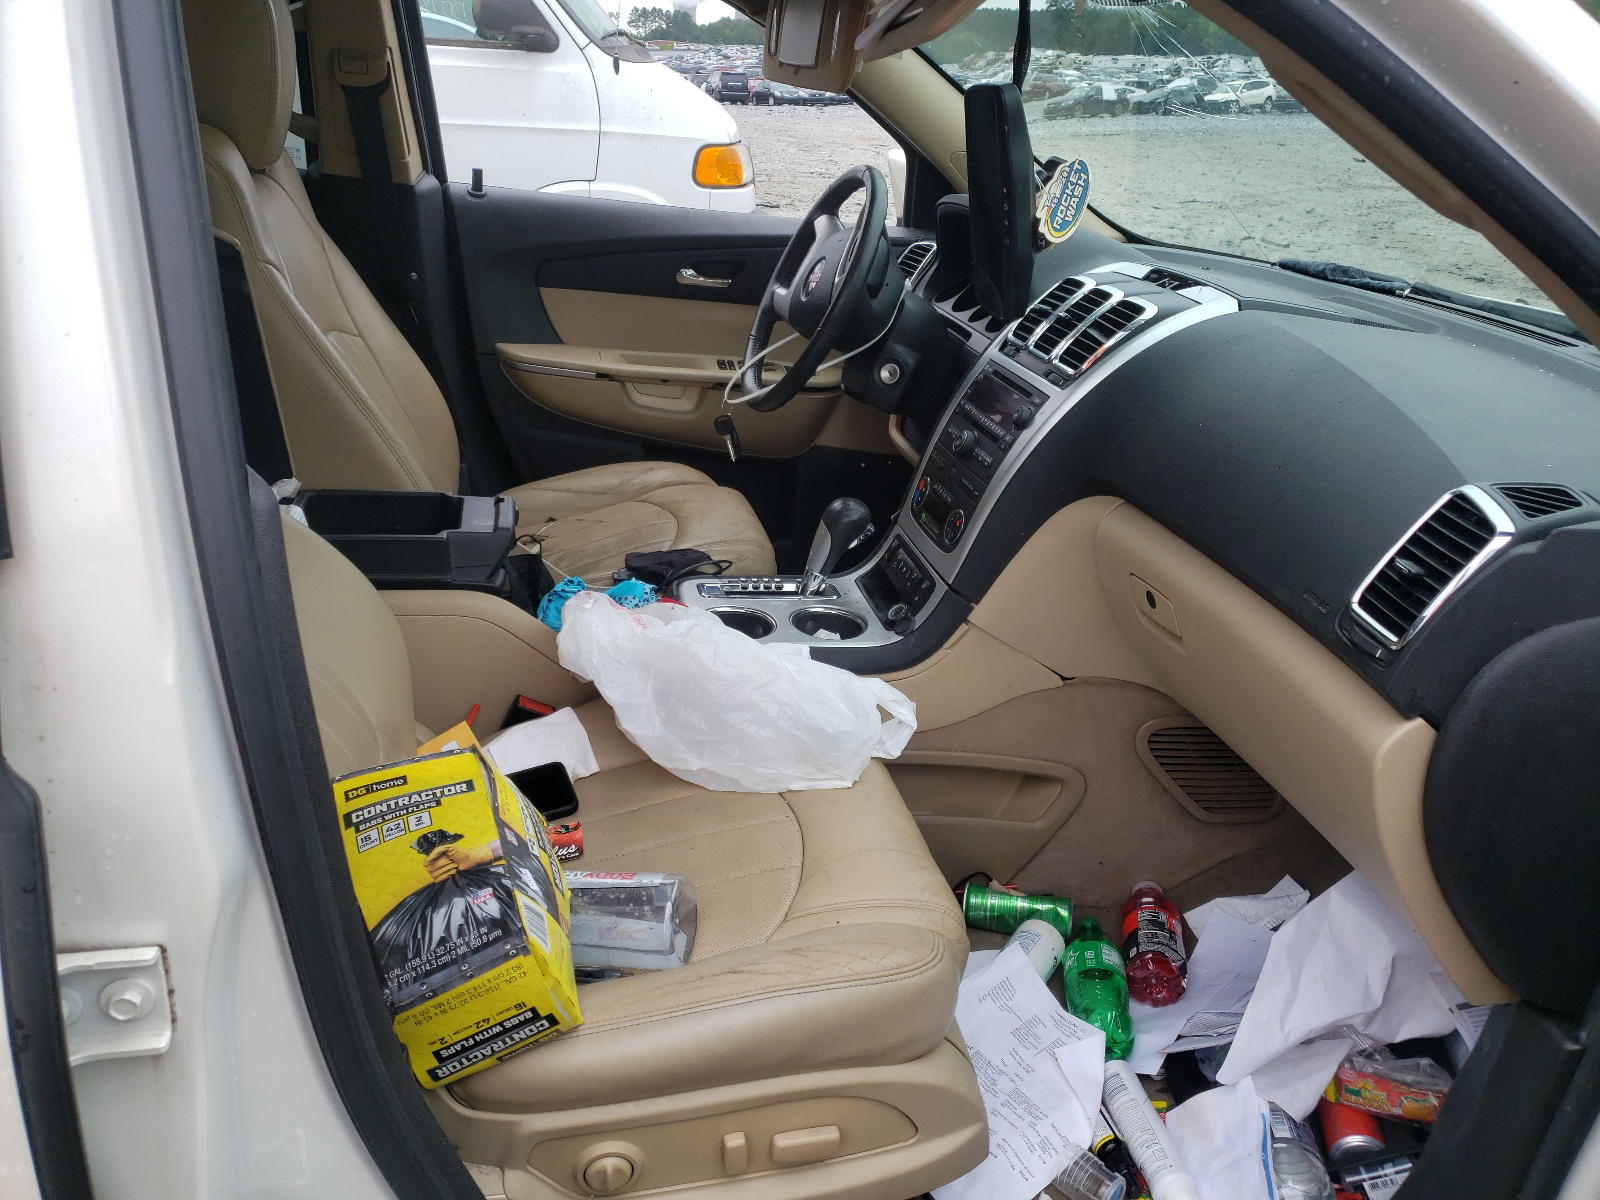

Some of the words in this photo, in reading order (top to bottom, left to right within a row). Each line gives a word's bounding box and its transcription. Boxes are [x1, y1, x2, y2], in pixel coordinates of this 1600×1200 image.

[1053, 160, 1082, 229] ROCKET
[1065, 172, 1088, 222] WASH
[347, 785, 367, 799] DG
[373, 778, 404, 790] home
[351, 783, 469, 823] CONTRACTOR
[359, 817, 383, 831] BAGS
[384, 809, 407, 821] WITH
[408, 801, 437, 813] FLAPS
[415, 815, 423, 823] 2
[386, 823, 402, 833] 42
[554, 844, 578, 857] lus
[405, 953, 427, 972] (158.9
[399, 974, 411, 984] cm
[473, 1017, 491, 1029] 42
[504, 1011, 533, 1029] BAGS
[438, 1036, 448, 1046] 2
[474, 1025, 504, 1042] WITH
[435, 1019, 551, 1078] CONTRACTOR
[440, 1038, 474, 1058] FLAPS
